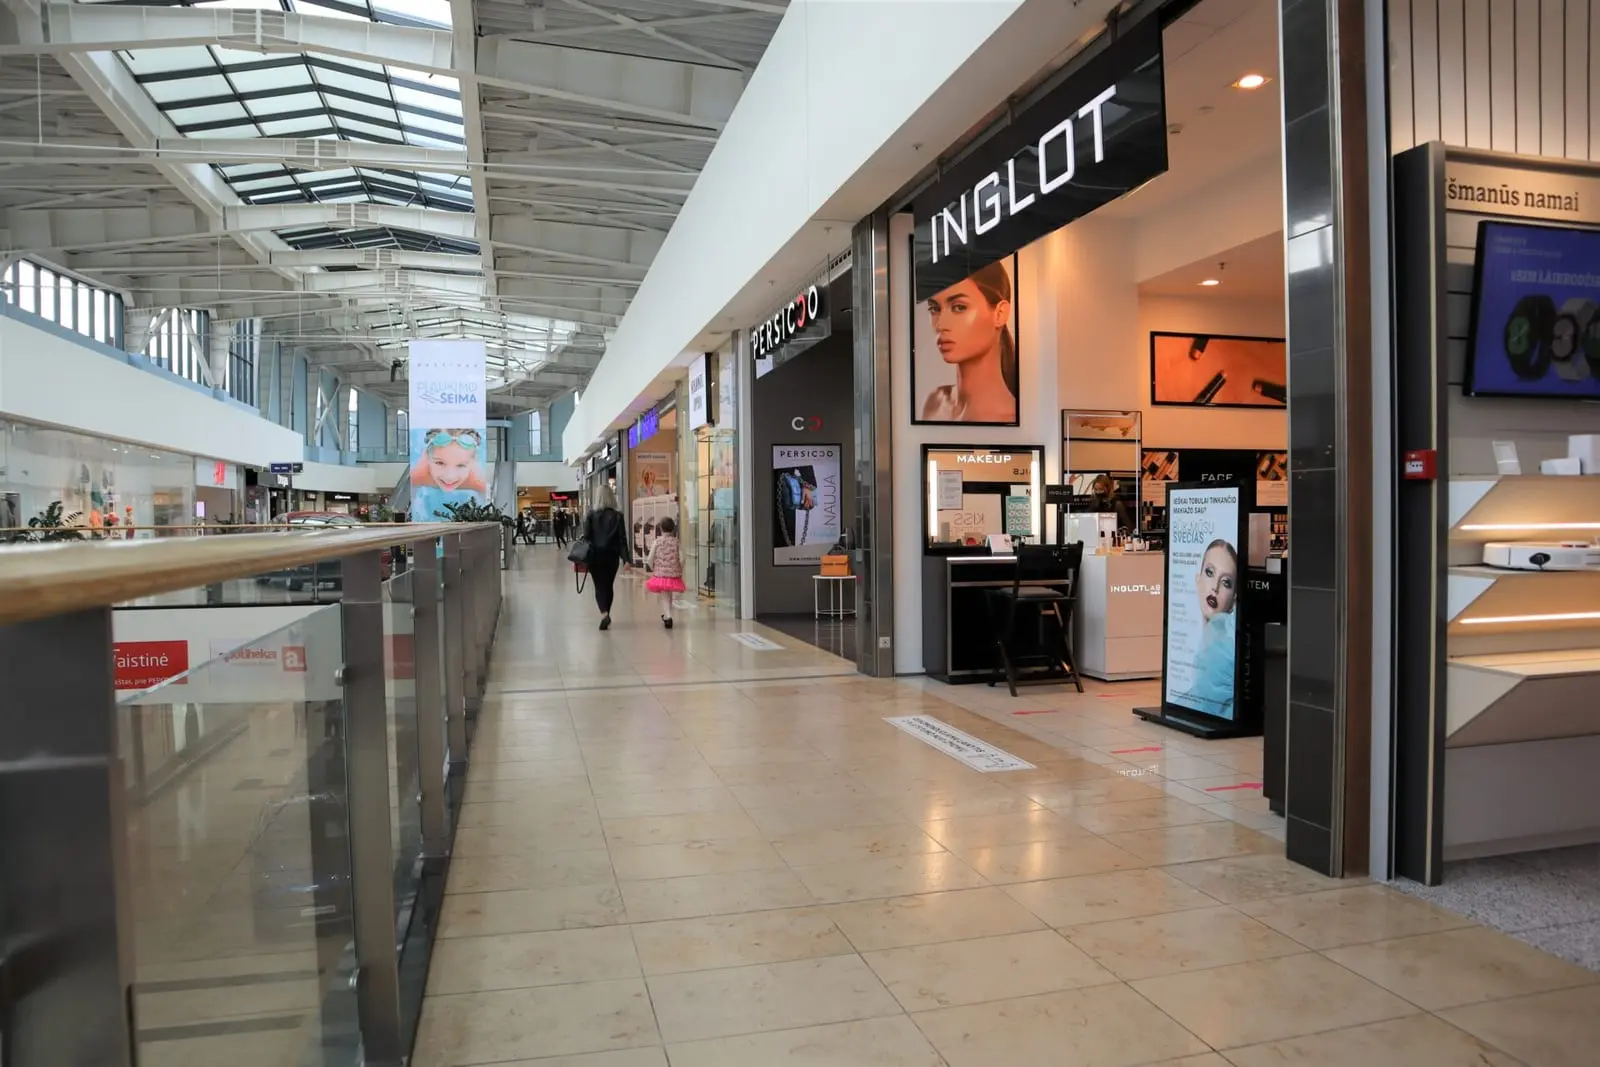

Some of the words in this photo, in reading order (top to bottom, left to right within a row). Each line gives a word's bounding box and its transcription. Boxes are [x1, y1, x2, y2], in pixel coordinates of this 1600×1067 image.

[931, 84, 1117, 264] INGLOT
[1445, 177, 1520, 206] šmanūs
[1524, 191, 1580, 212] namai
[956, 454, 1012, 464] MAKEUP
[824, 474, 837, 527] NAUJA
[113, 652, 169, 668] aistinė
